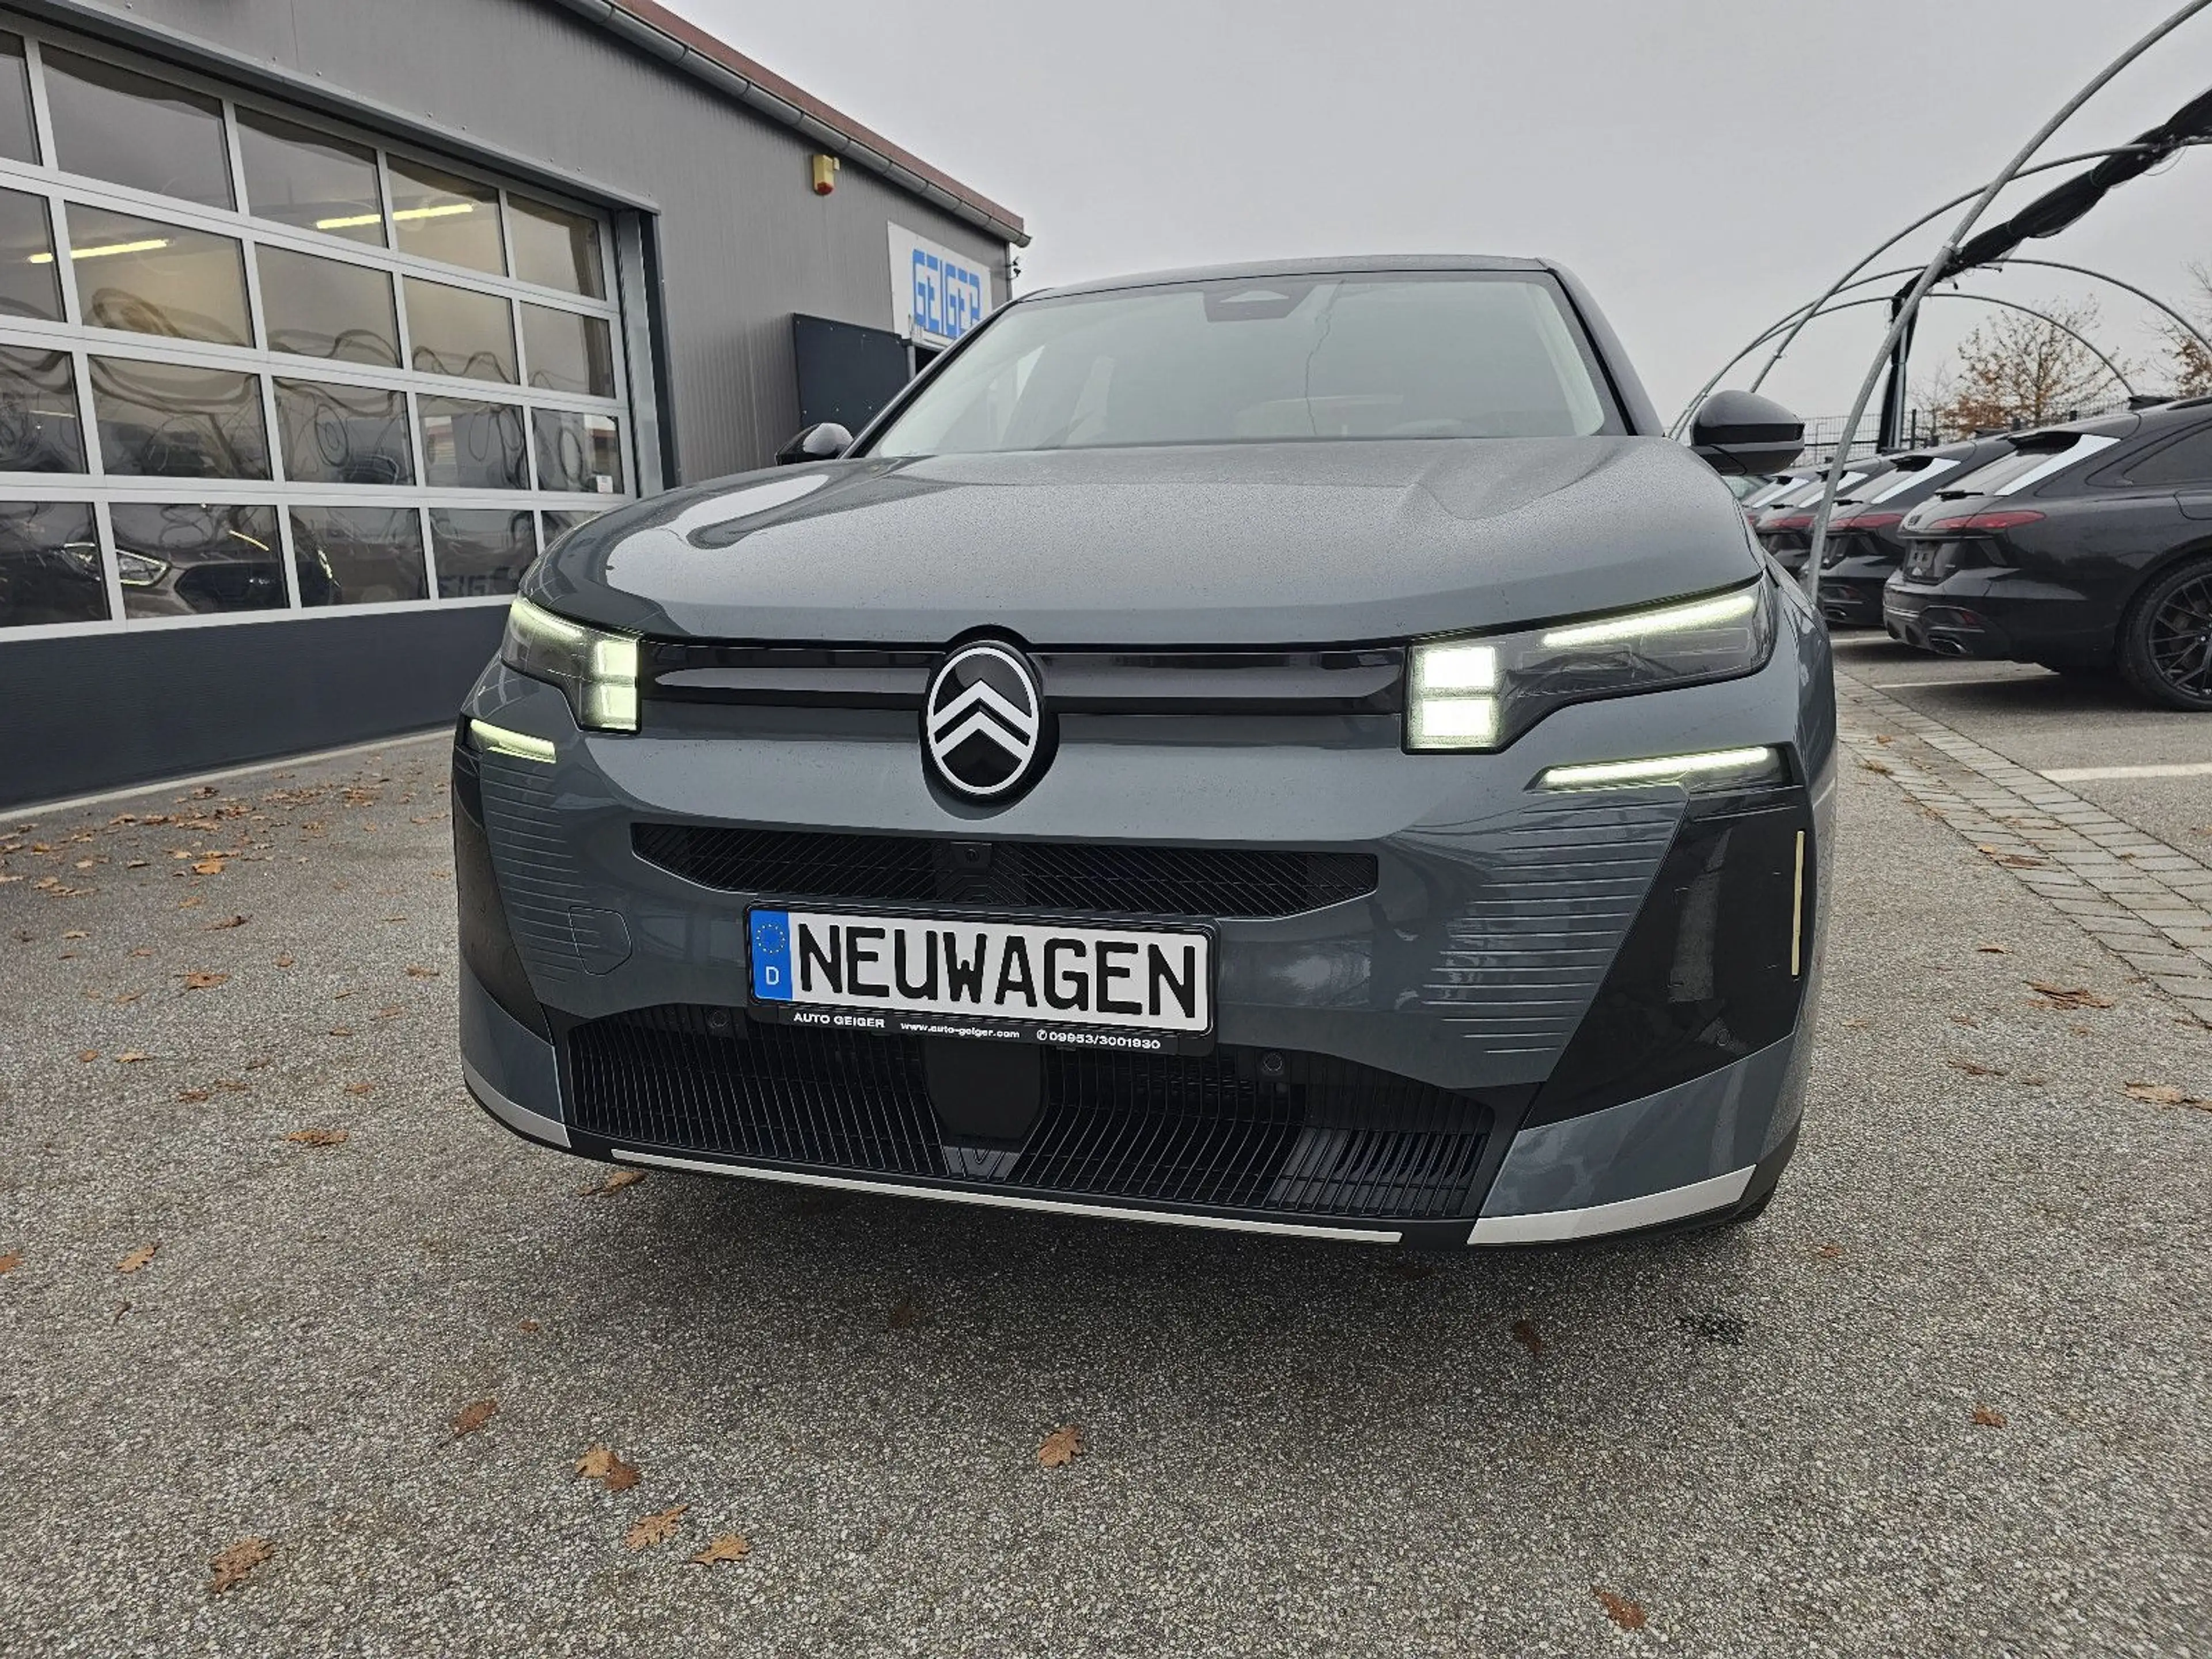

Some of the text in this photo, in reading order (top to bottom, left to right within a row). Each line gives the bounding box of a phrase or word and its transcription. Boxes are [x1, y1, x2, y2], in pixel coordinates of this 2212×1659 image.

[912, 248, 981, 339] GEIGER
[766, 966, 779, 985] D
[798, 923, 1195, 1018] NEUWAGEN
[793, 1012, 831, 1024] AUTO
[834, 1015, 885, 1028] GEIGER
[900, 1022, 1020, 1037] www.auto-geiger.com
